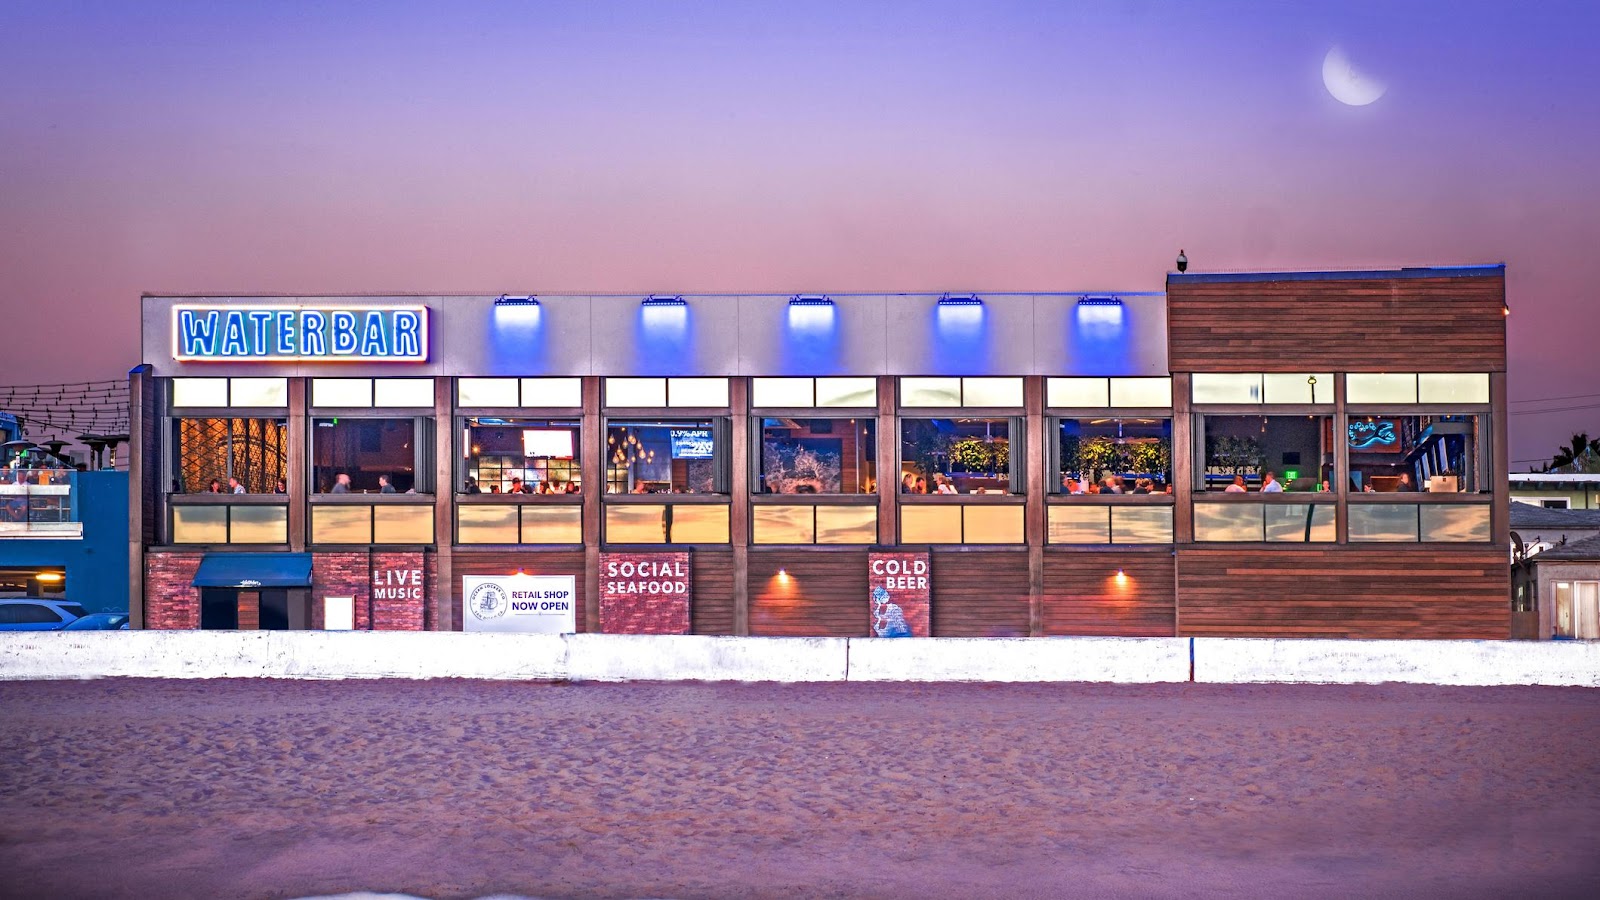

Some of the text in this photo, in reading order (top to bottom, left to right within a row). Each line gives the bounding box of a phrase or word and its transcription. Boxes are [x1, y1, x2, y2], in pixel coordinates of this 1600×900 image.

[180, 310, 420, 356] WATERBAR
[608, 562, 685, 578] SOCIAL
[872, 559, 927, 574] COLD
[374, 569, 422, 585] LIVE
[886, 576, 927, 589] BEER
[374, 588, 421, 599] MUSIC
[607, 581, 686, 594] SEAFOOD
[512, 591, 569, 599] RETAIL SHOP
[512, 601, 569, 610] NOW OPEN
